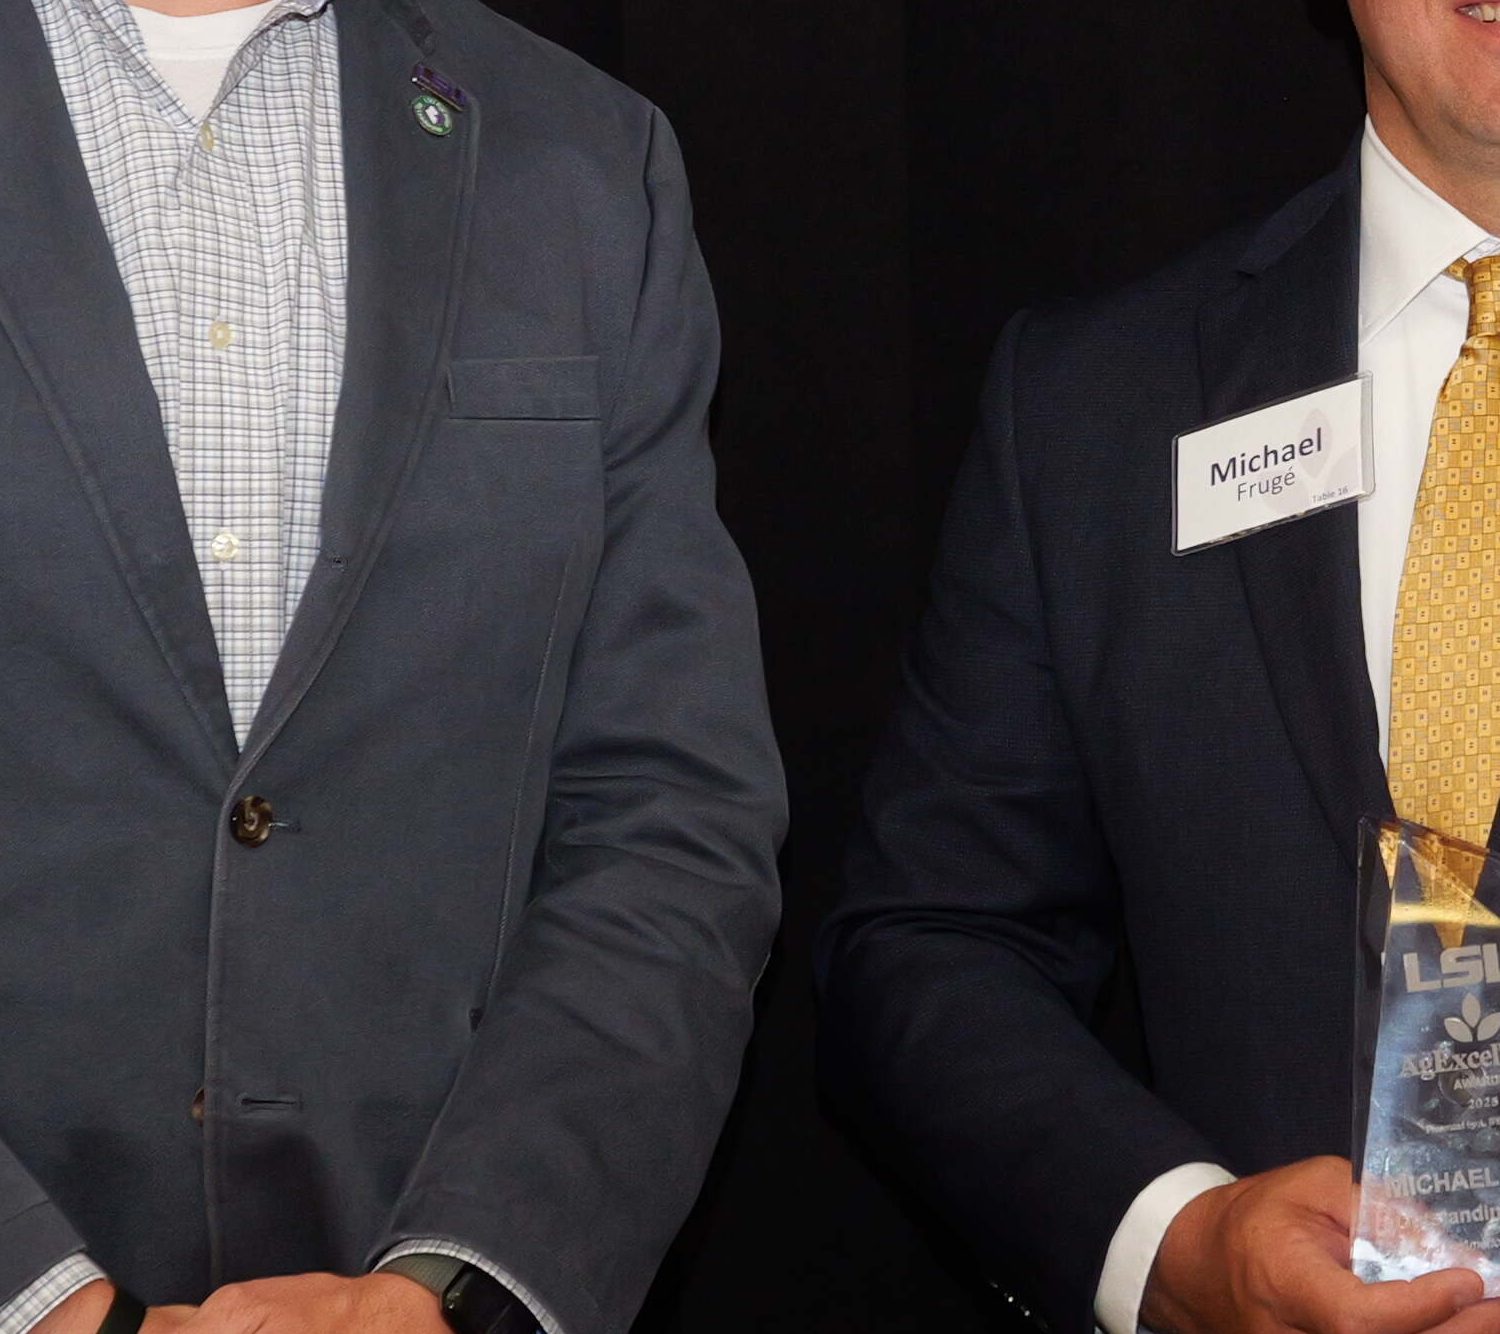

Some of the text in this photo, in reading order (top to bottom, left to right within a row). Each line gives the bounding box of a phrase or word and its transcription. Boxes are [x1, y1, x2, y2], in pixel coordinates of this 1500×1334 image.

[1209, 427, 1322, 486] Michael
[1237, 466, 1296, 502] Frugé
[1384, 1167, 1500, 1199] MICHAEL
